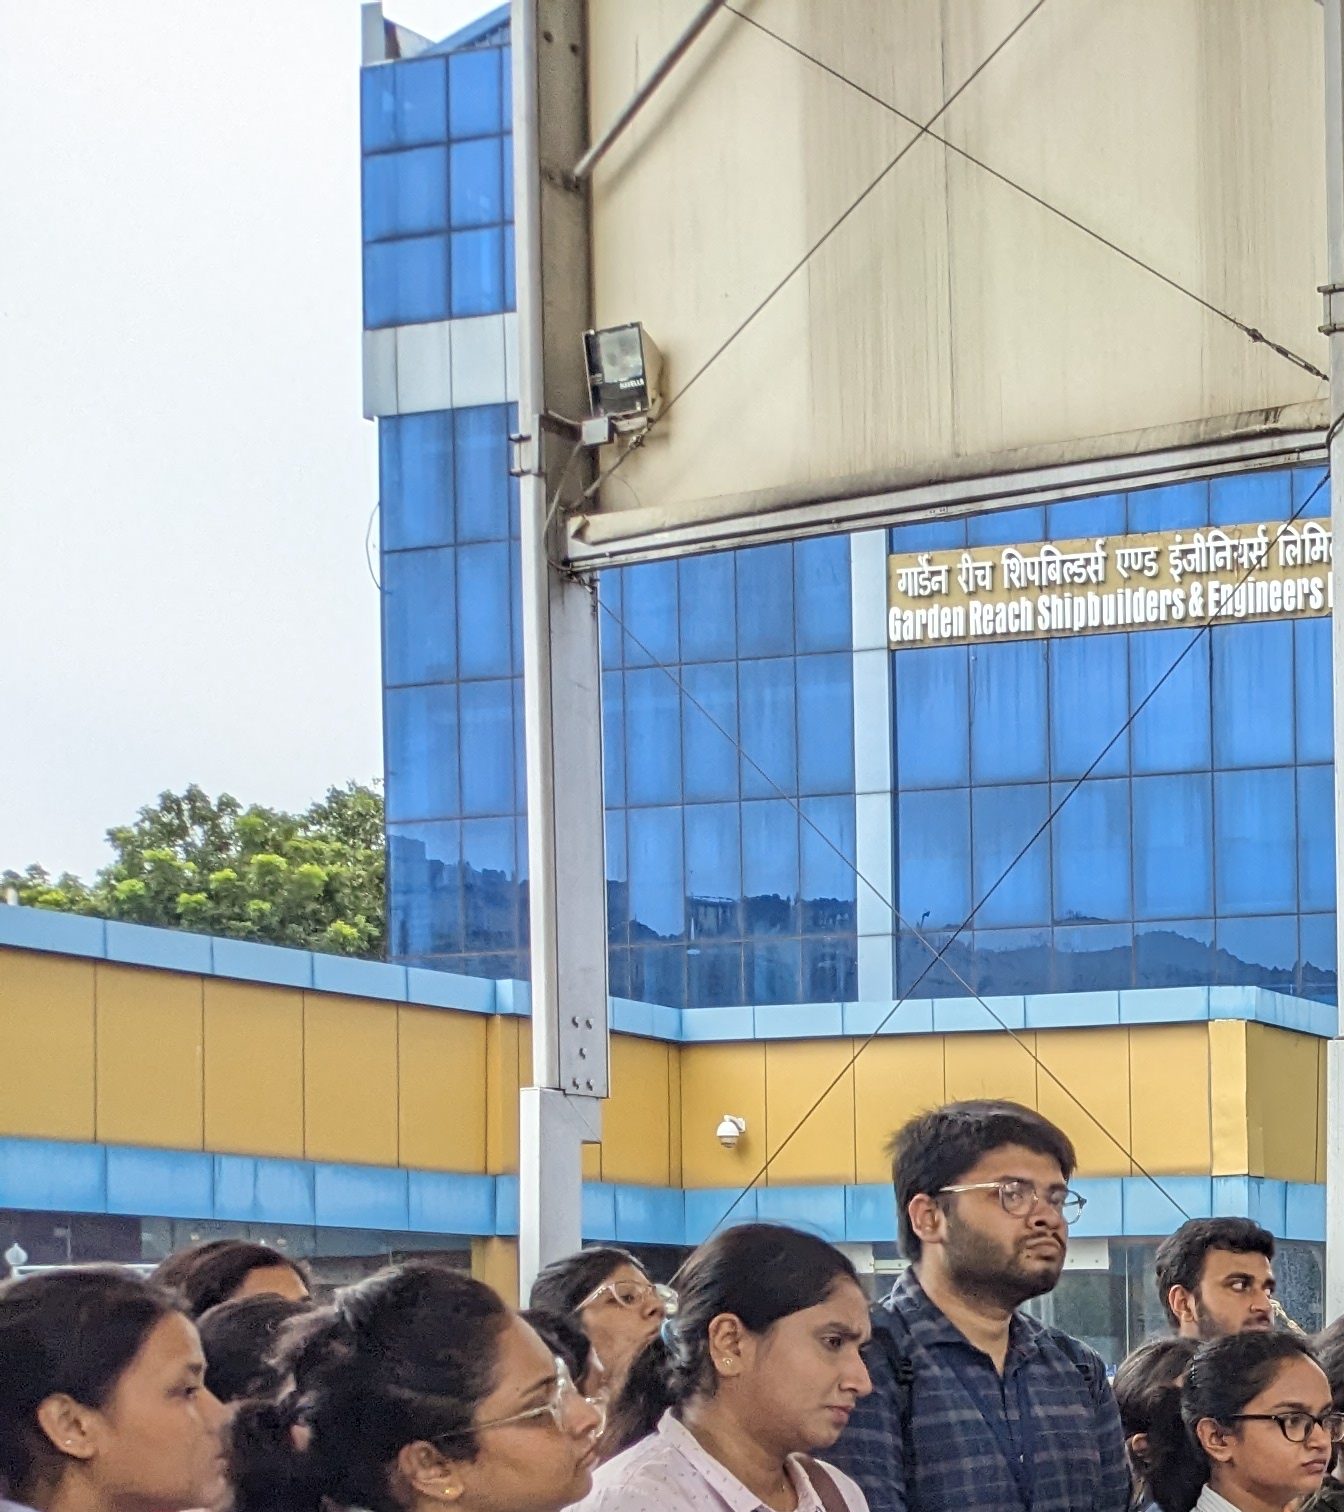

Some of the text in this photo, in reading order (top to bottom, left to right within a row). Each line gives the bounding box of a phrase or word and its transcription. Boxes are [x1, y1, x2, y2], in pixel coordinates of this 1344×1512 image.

[957, 552, 995, 595] रीच
[1001, 539, 1107, 590] शिपबिल्डर्स
[1116, 546, 1160, 579] एण्ड
[1168, 524, 1270, 583] इंजीनियर्स
[1277, 521, 1333, 568] लिमि
[888, 603, 966, 642] Garden
[969, 597, 1034, 636] Reach
[1037, 586, 1186, 632] Shipbuilders
[1189, 581, 1206, 618] &
[1208, 576, 1324, 618] Engineers
